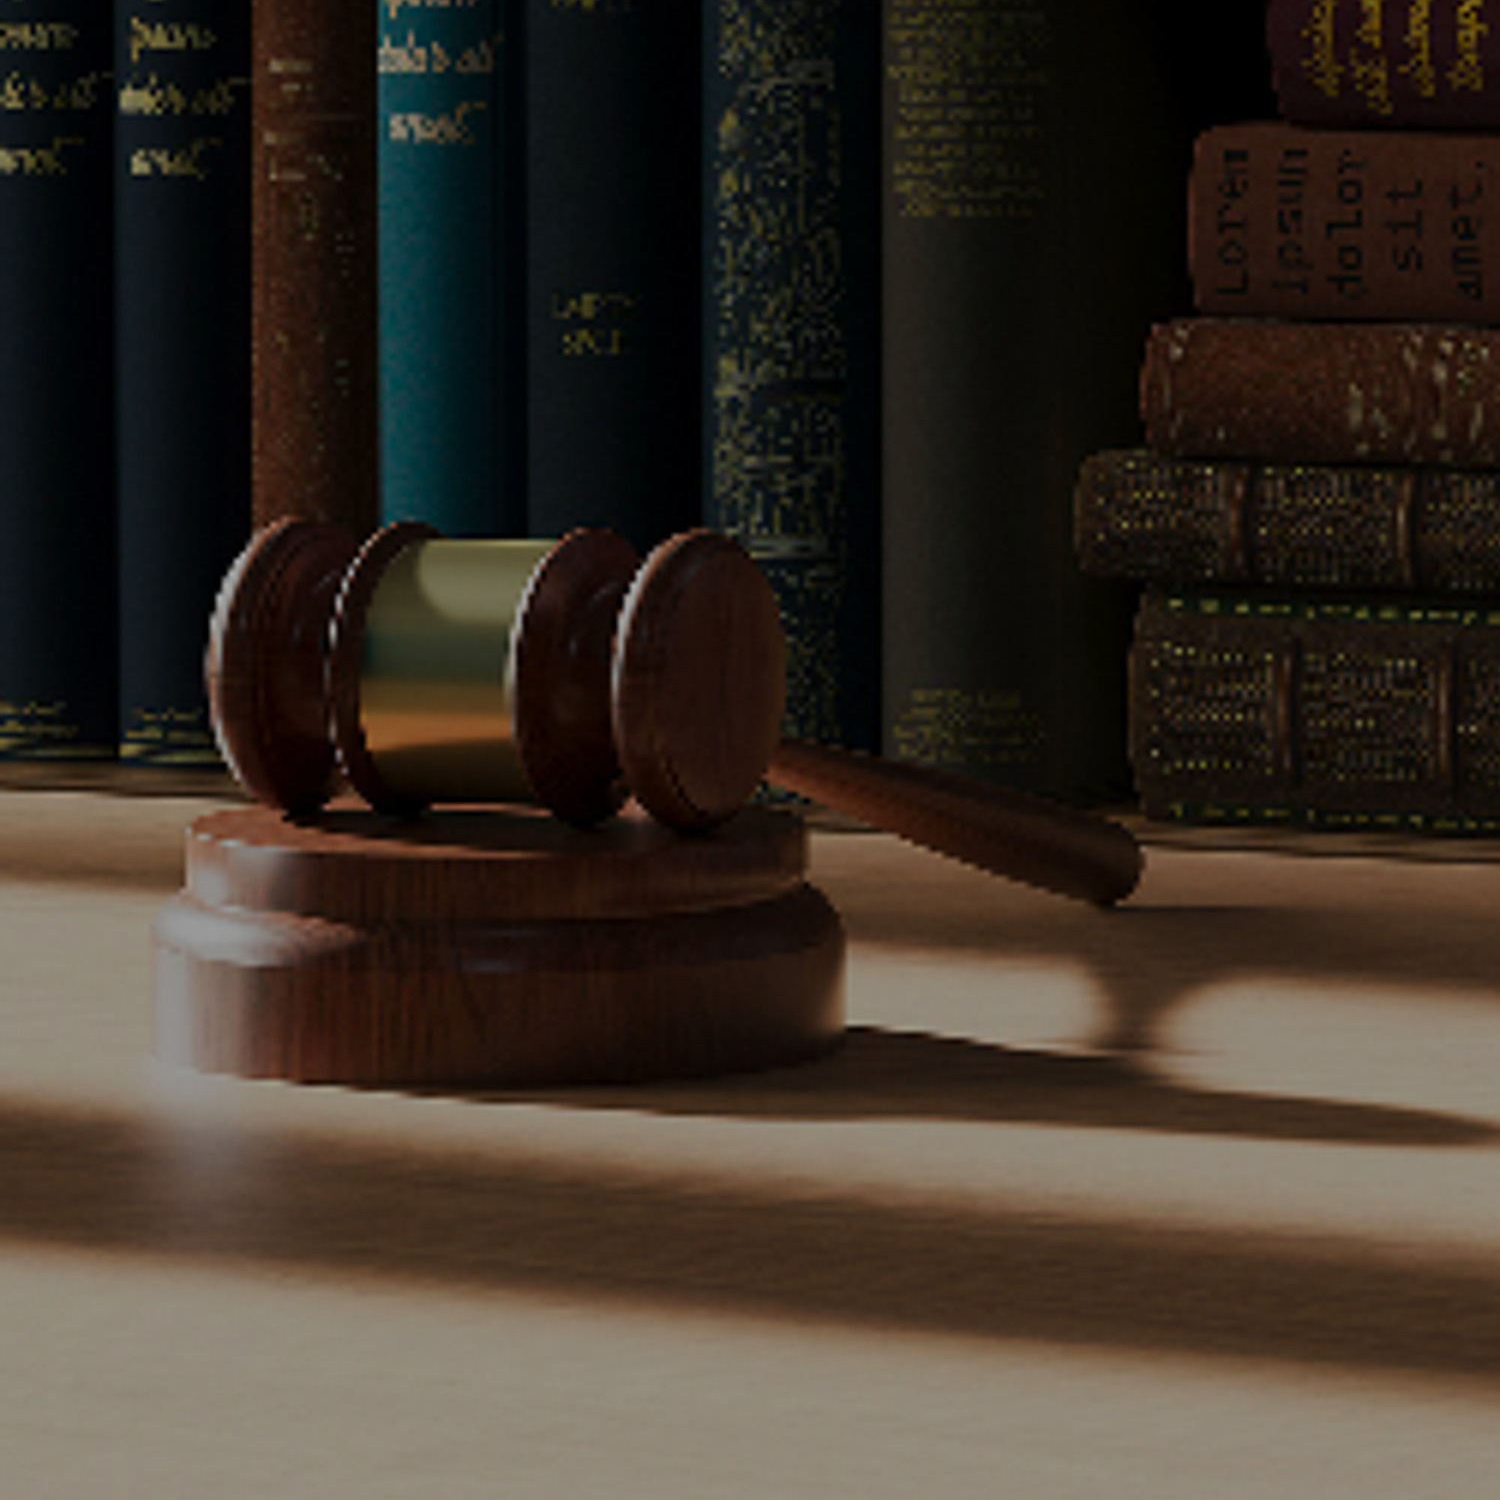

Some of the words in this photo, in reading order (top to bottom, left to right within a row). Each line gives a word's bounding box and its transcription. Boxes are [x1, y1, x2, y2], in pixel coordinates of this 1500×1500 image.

[1214, 149, 1249, 295] Lorem
[1325, 149, 1367, 299] dolor
[1384, 179, 1423, 271] sit
